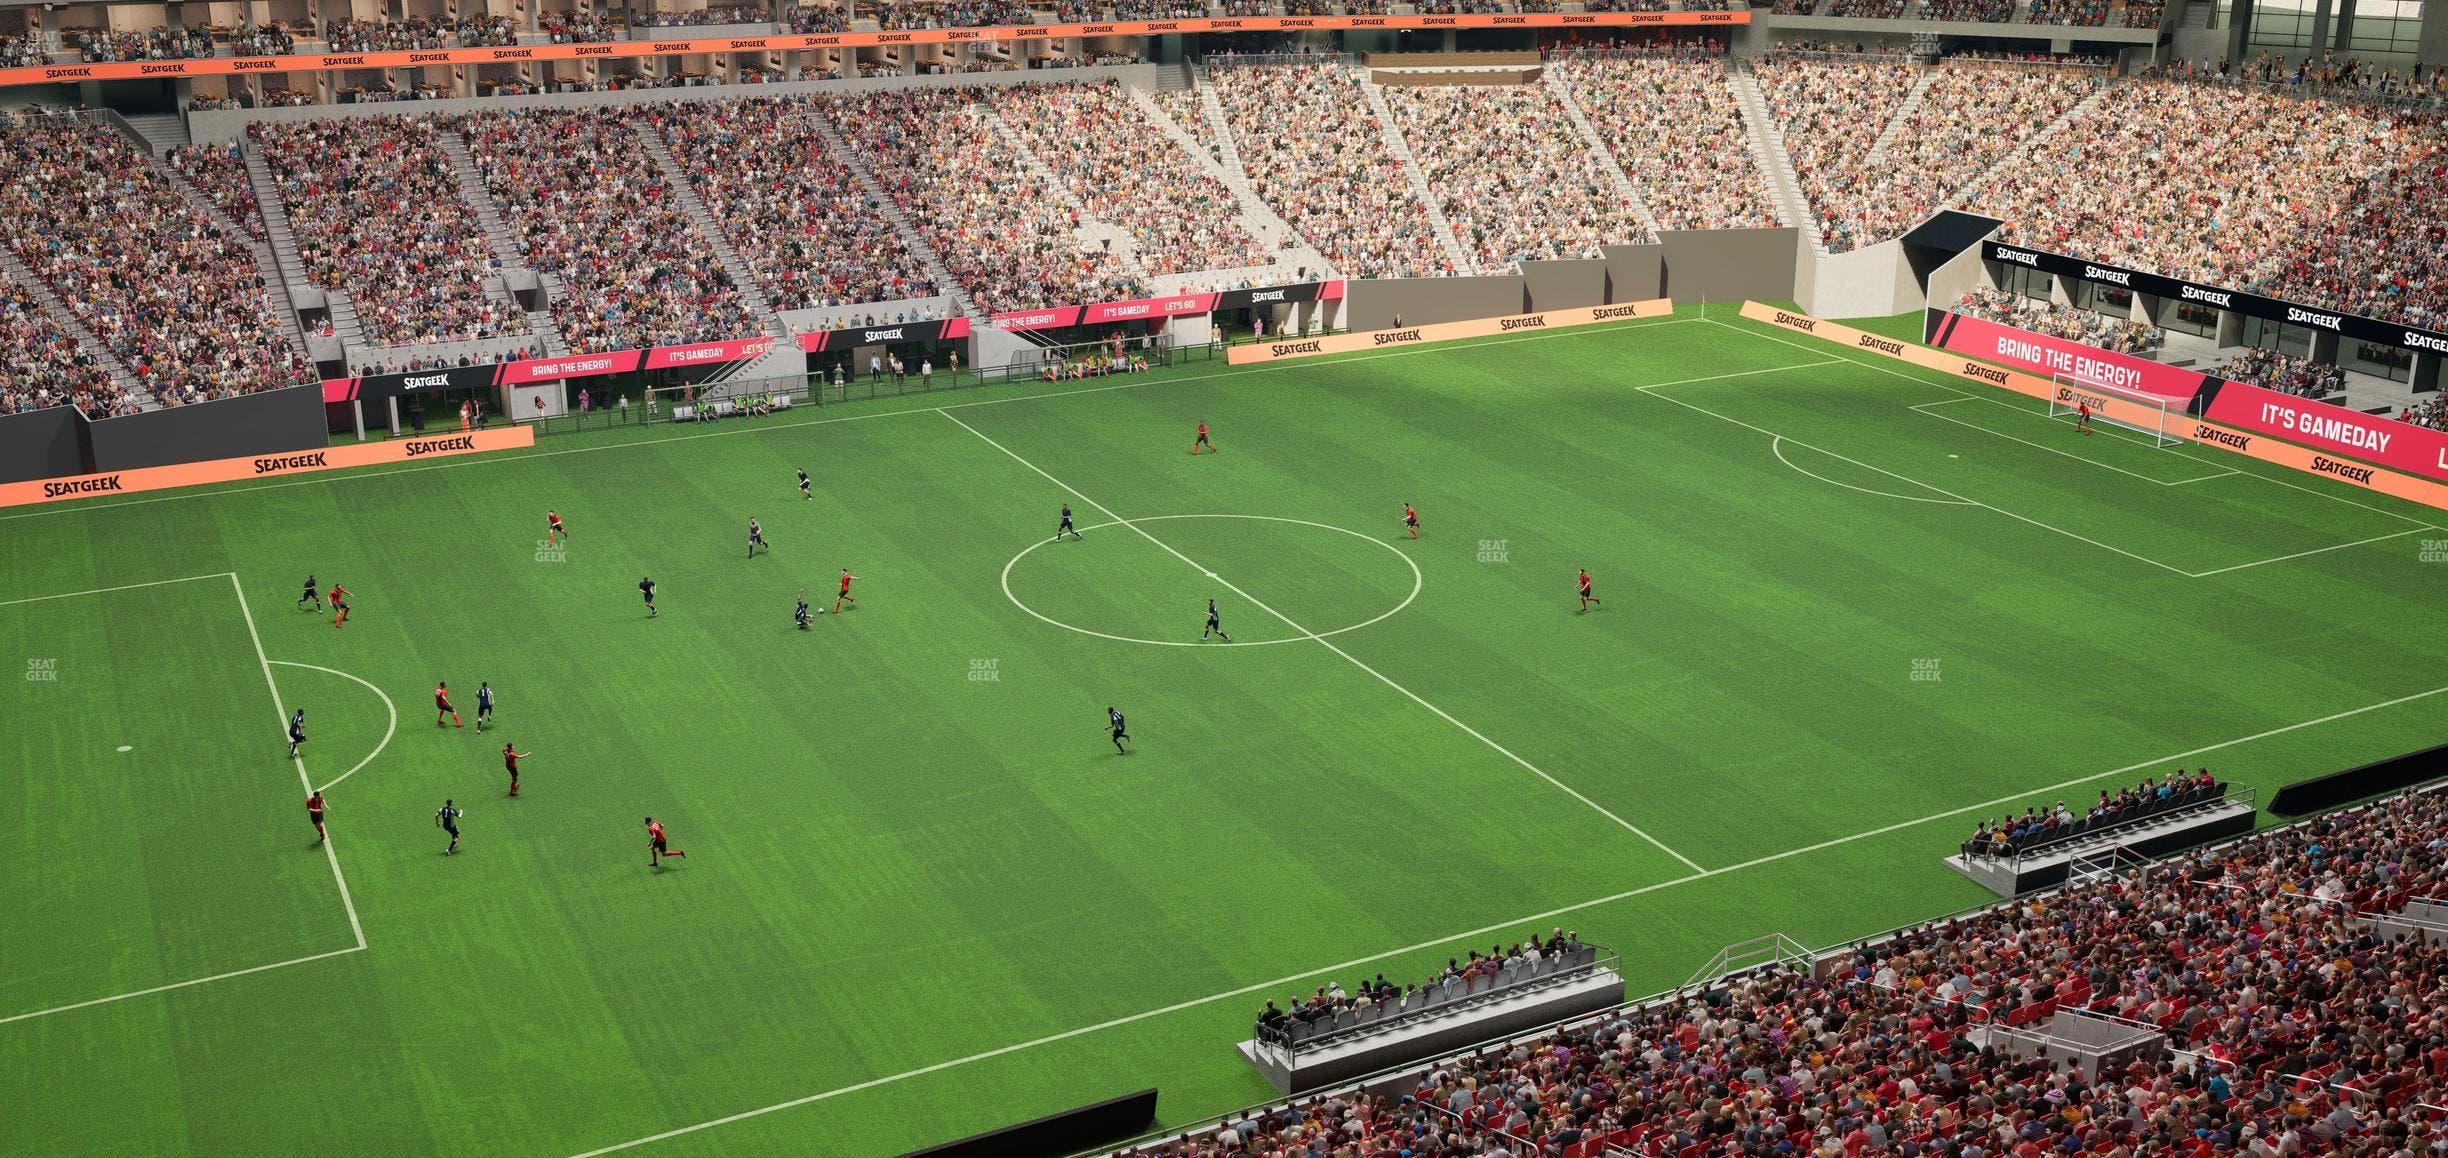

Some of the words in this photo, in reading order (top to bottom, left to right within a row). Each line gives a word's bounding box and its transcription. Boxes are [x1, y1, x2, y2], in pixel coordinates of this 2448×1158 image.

[1210, 20, 1242, 28] SEATGEEK
[1280, 19, 1314, 28] SEATGEEK
[1352, 18, 1386, 26] SEATGEEK
[1493, 16, 1526, 24] SEATGEEK
[1562, 16, 1595, 24] SEATGEEK
[1631, 15, 1664, 23] SEATGEEK
[1700, 14, 1732, 22] SEATGEEK
[1016, 28, 1048, 37] SEATGEEK
[1083, 25, 1114, 34] SEATGEEK
[1147, 23, 1178, 31] SEATGEEK
[805, 36, 840, 46] SEATGEEK
[878, 34, 911, 43] SEATGEEK
[948, 31, 980, 40] SEATGEEK
[654, 43, 690, 52] SEATGEEK
[731, 40, 766, 48] SEATGEEK
[494, 49, 533, 59] SEATGEEK
[575, 46, 612, 56] SEATGEEK
[323, 56, 364, 66] SEATGEEK
[410, 53, 450, 63] SEATGEEK
[141, 63, 185, 74] SEATGEEK
[233, 60, 276, 70] SEATGEEK
[46, 67, 91, 79] SEATGEEK
[1996, 247, 2038, 266] SEATGEEK
[2085, 265, 2130, 286] SEATGEEK
[1252, 289, 1285, 303] SEATGEEK
[2181, 285, 2231, 307] SEATGEEK
[1103, 306, 1116, 317] IT'S
[1118, 304, 1150, 316] GAMEDAY
[1165, 301, 1178, 311] LET'S
[1593, 303, 1637, 321] SEATGEEK
[1026, 314, 1056, 326] ENERGY!
[1500, 315, 1546, 332] SEATGEEK
[1774, 311, 1817, 333] SEATGEEK
[2287, 307, 2342, 331] SEATGEEK
[865, 328, 903, 343] SEATGEEK
[1374, 328, 1421, 346] SEATGEEK
[1272, 340, 1322, 357] SEATGEEK
[1858, 333, 1905, 357] SEATGEEK
[669, 350, 685, 362] IT'S
[686, 347, 724, 361] GAMEDAY
[532, 362, 557, 376] BRING
[559, 361, 575, 374] THE
[577, 359, 612, 373] ENERGY!
[1997, 337, 2042, 364] BRING
[2046, 348, 2073, 372] THE
[2075, 356, 2142, 389] ENERGY!
[1963, 362, 2010, 386] SEATGEEK
[405, 374, 449, 389] SEATGEEK
[2261, 403, 2296, 429] IT'S
[2300, 412, 2392, 453] GAMEDAY
[2194, 424, 2251, 452] SEATGEEK
[405, 436, 474, 456] SEATGEEK
[254, 452, 327, 474] SEATGEEK
[2311, 455, 2375, 485] SEATGEEK
[44, 475, 122, 498] SEATGEEK
